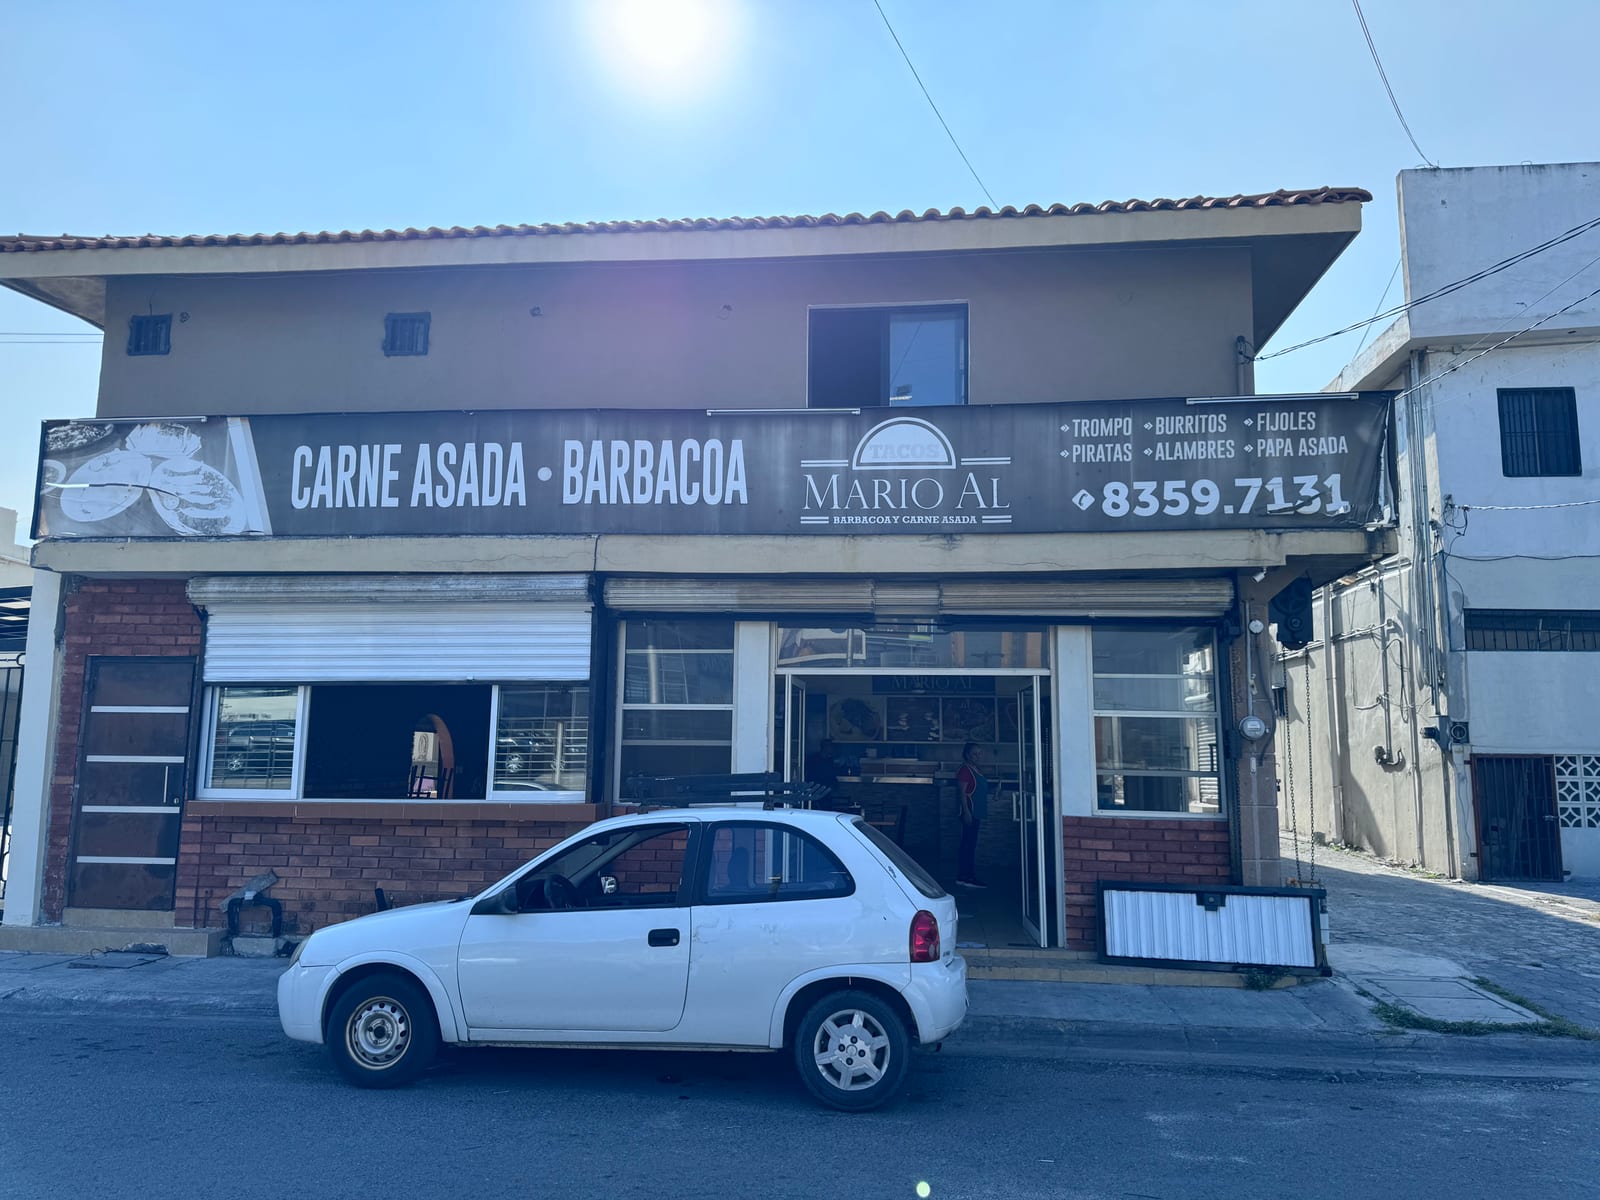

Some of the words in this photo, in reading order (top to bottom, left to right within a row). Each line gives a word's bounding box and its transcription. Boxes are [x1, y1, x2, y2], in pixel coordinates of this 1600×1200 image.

[1071, 417, 1133, 438] TROMPO
[1155, 413, 1227, 435] BURRITOS
[1257, 411, 1316, 432] FIJOLES
[870, 443, 939, 459] TACOS
[1072, 442, 1133, 463] PIRATAS
[1155, 439, 1235, 461] ALAMBRES
[1257, 438, 1294, 458] PAPA
[1298, 436, 1349, 457] ASADA
[291, 444, 401, 509] CARNE
[410, 442, 527, 508] ASADA
[563, 439, 748, 505] BARBACOA
[802, 473, 944, 511] MARIO
[956, 473, 1010, 509] AL
[1102, 474, 1350, 517] 8359.7131
[902, 515, 940, 524] CARNE
[941, 515, 978, 524] ASADA
